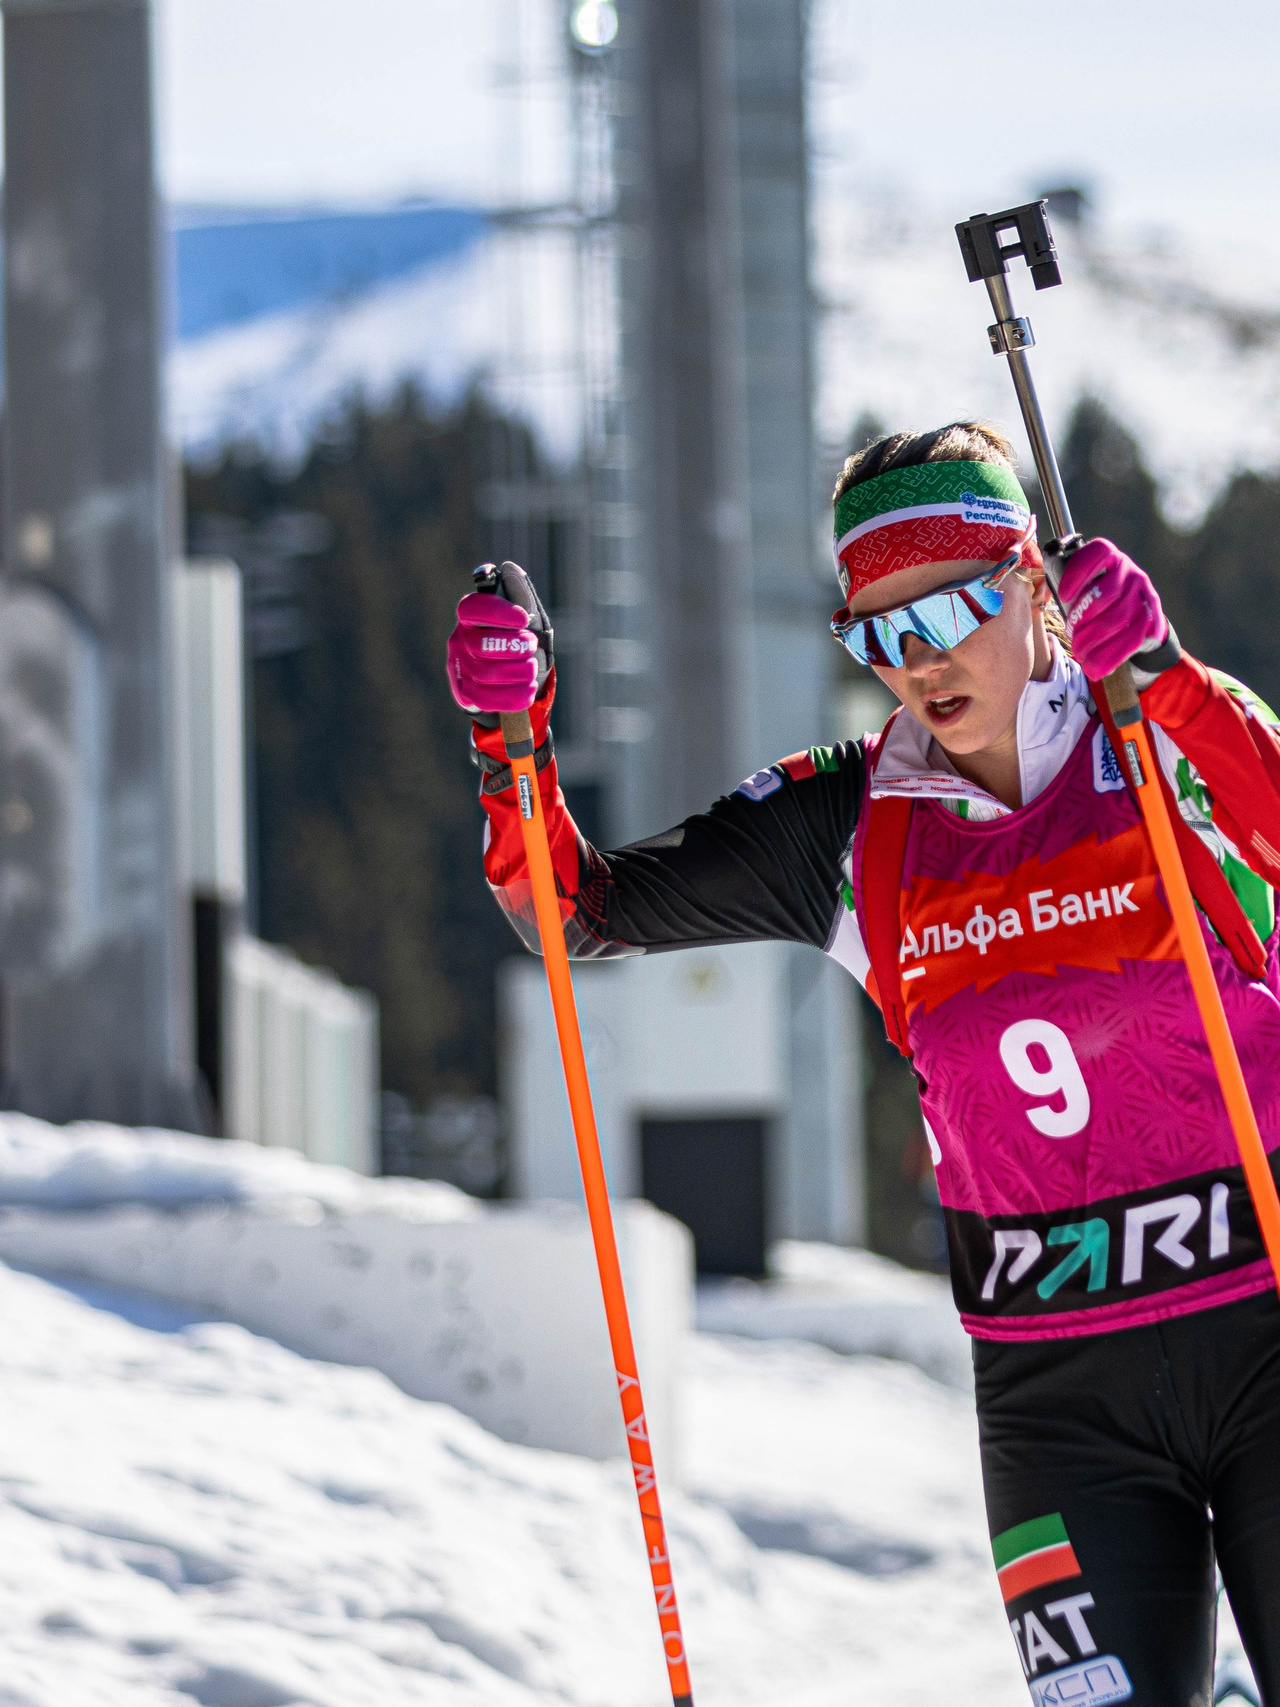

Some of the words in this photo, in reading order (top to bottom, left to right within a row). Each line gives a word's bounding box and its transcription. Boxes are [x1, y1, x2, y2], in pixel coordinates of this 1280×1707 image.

[899, 904, 1024, 964] Альфа
[1028, 882, 1140, 932] Банк
[999, 1018, 1090, 1138] 9
[981, 1182, 1230, 1300] PARI
[615, 1369, 657, 1496] WAY
[648, 1536, 686, 1664] ONE
